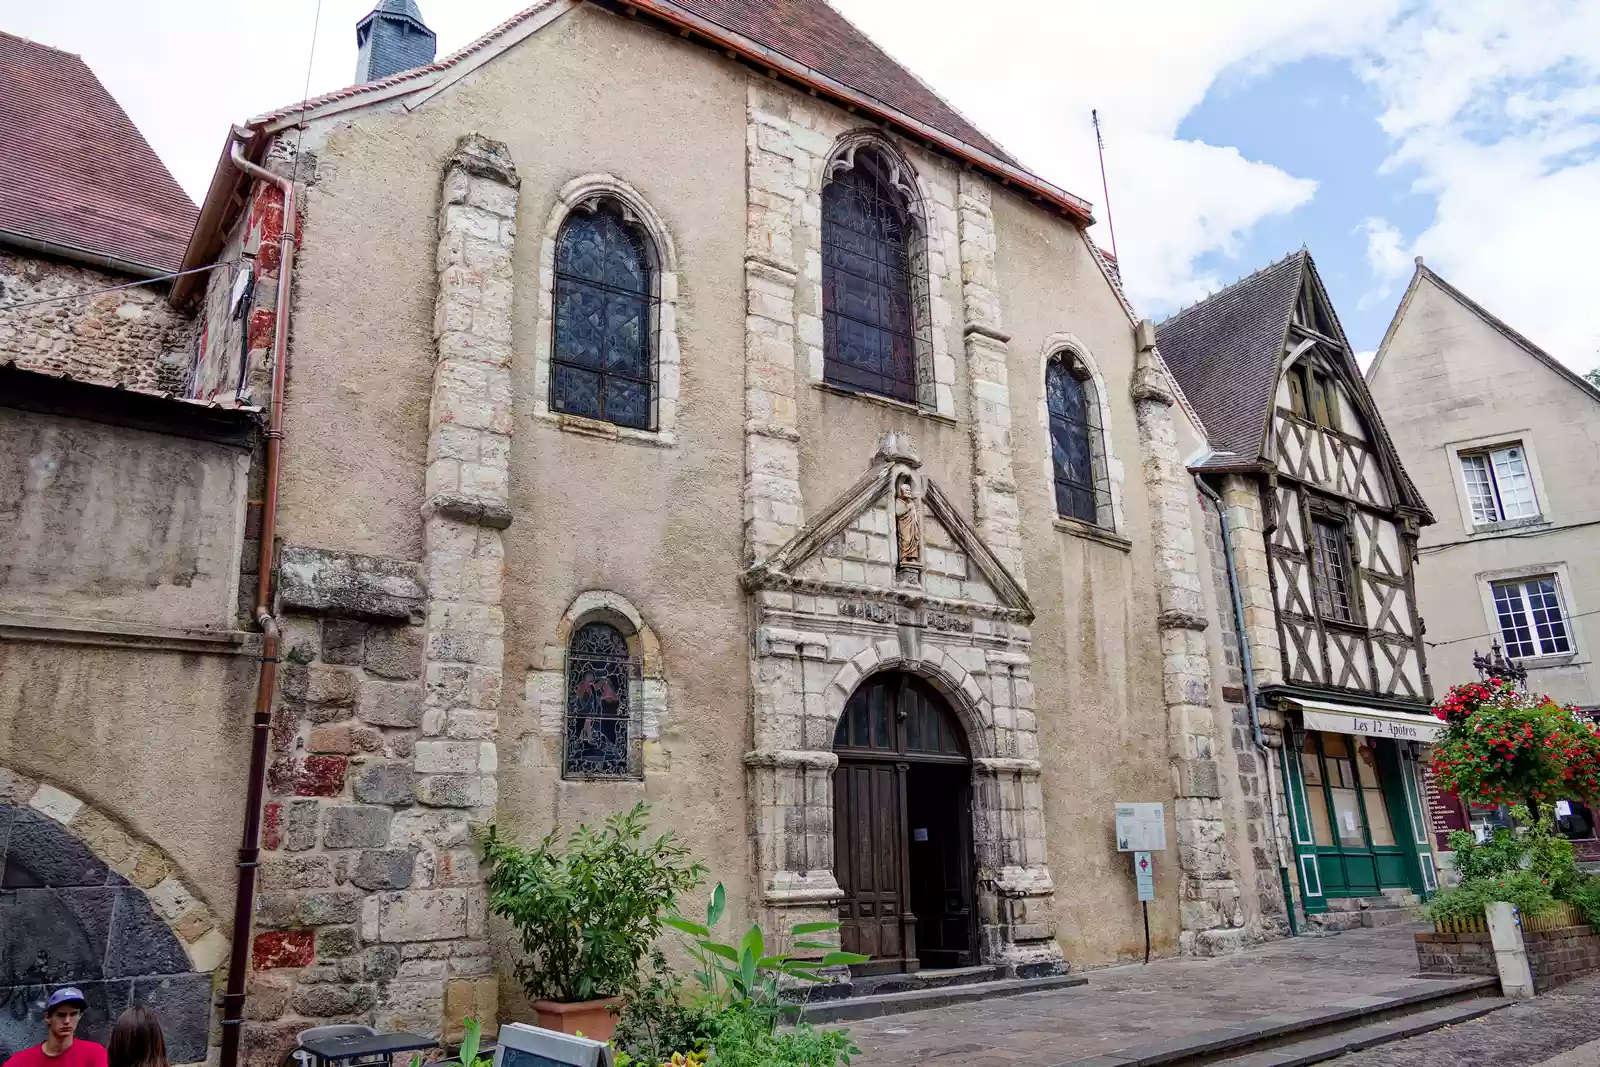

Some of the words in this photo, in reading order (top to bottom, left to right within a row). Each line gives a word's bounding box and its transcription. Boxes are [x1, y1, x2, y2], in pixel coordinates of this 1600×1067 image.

[1353, 718, 1368, 731] Les
[1372, 720, 1383, 733] 12
[1387, 721, 1417, 738] Apôtres
